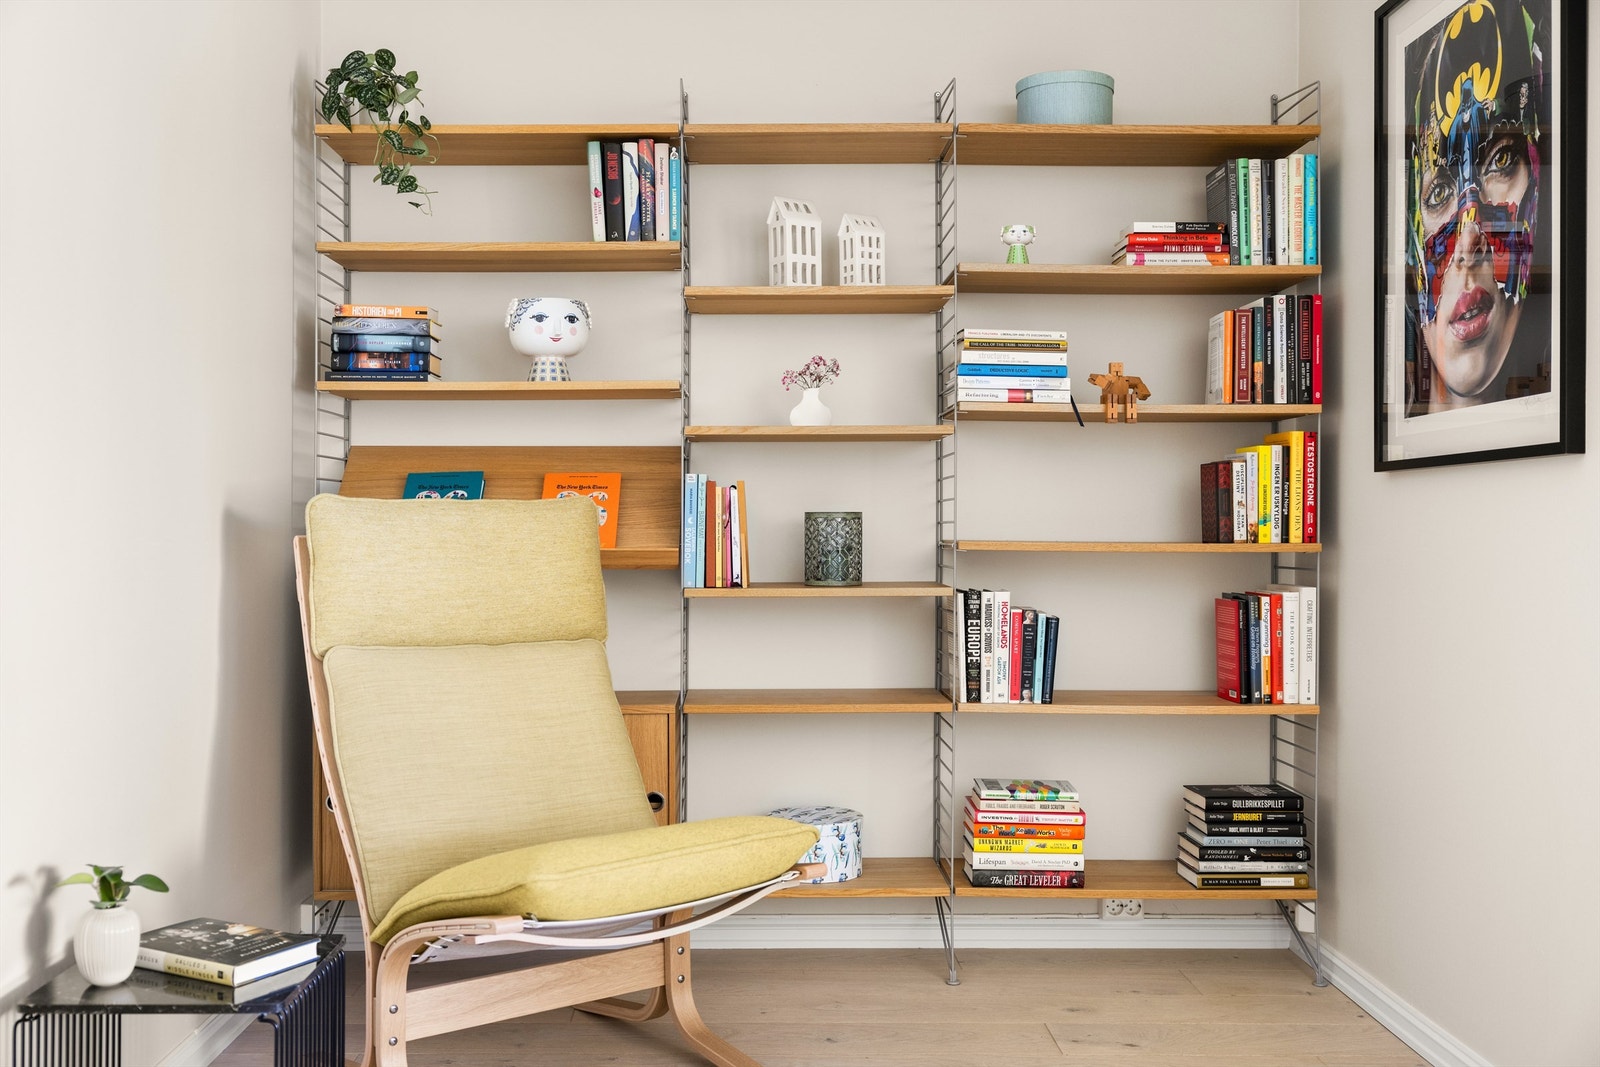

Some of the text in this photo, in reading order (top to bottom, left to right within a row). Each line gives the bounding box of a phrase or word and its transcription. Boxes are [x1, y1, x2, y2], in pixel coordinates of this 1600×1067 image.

[607, 152, 618, 160] JO
[1253, 177, 1261, 211] Atomic
[1294, 197, 1302, 219] MASTER
[1294, 221, 1302, 252] ALGORITHM
[352, 306, 402, 316] HISTORIEN PI
[1274, 486, 1280, 495] ER
[968, 620, 980, 663] EUROPE
[1233, 813, 1263, 821] JERNBURET
[979, 857, 1007, 867] Lifespan
[991, 875, 1061, 886] The GREAT LEVELER
[167, 966, 214, 979] MIDDLE FINGER
